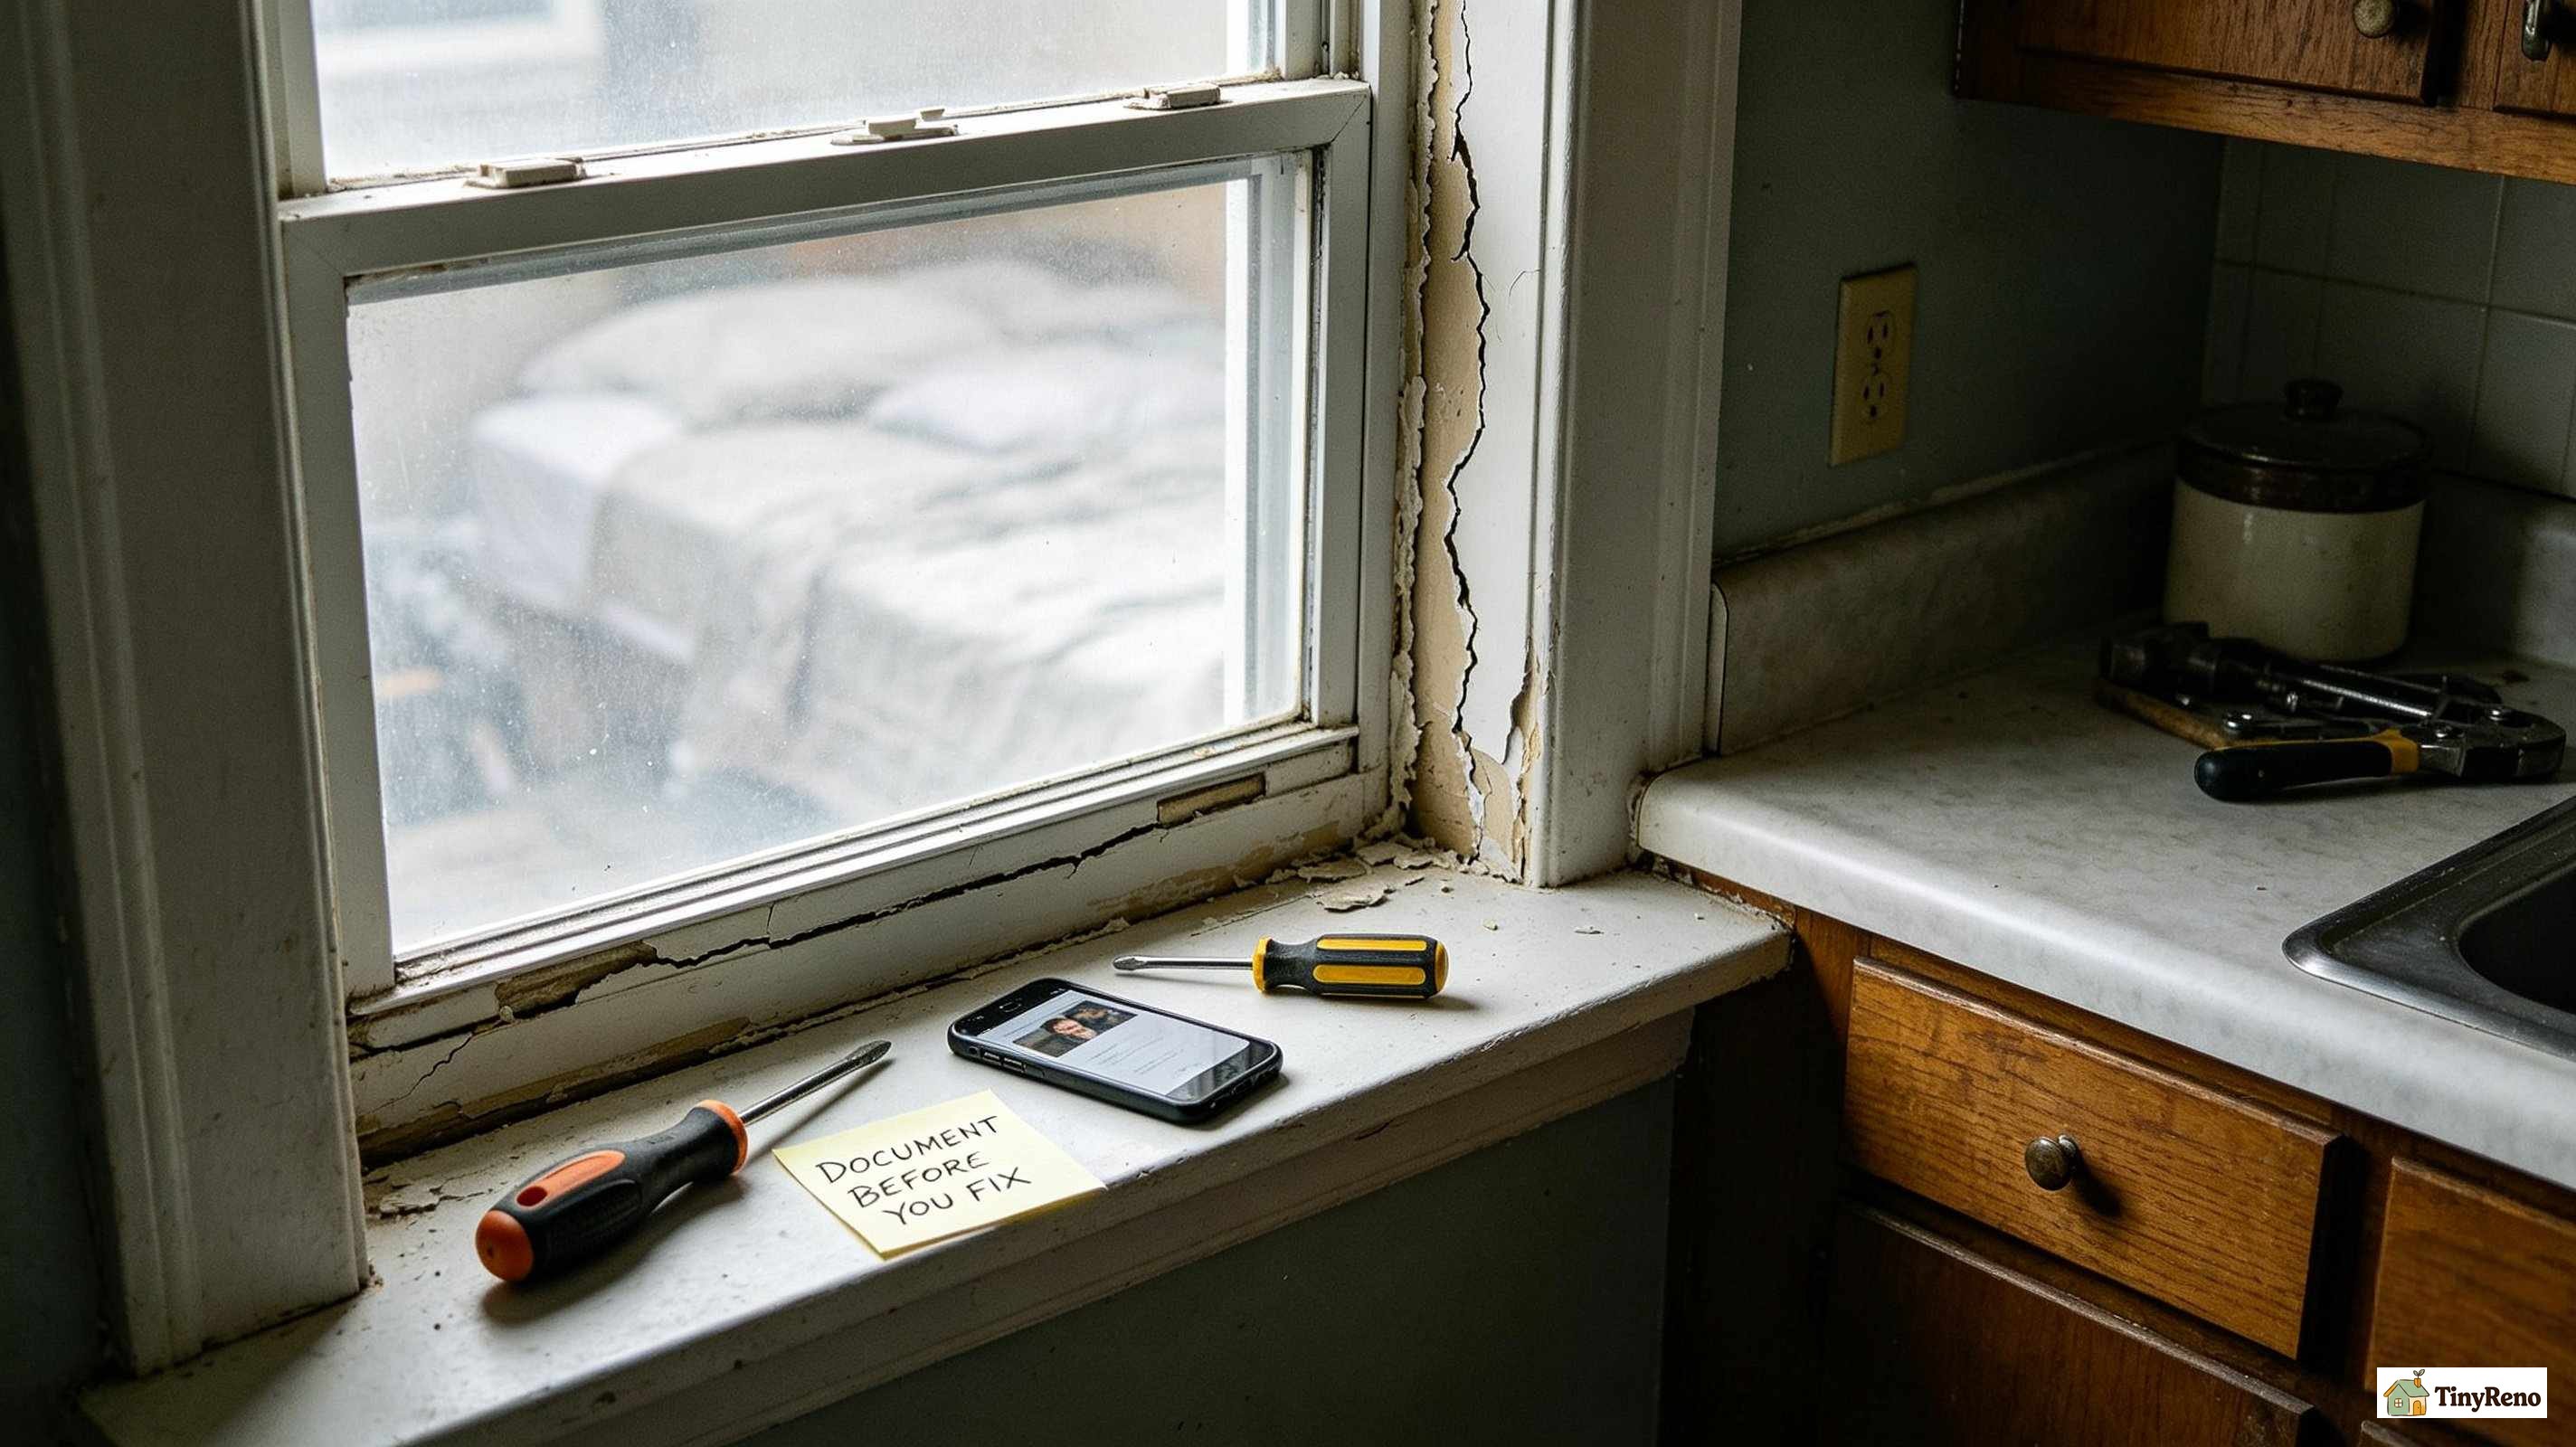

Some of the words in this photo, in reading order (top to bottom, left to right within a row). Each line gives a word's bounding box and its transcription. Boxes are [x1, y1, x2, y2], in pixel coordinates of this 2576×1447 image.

[816, 1115, 998, 1183] DOCUMENT
[848, 1151, 989, 1207] BEFORE
[883, 1193, 953, 1225] YOU
[967, 1167, 1031, 1202] FIX
